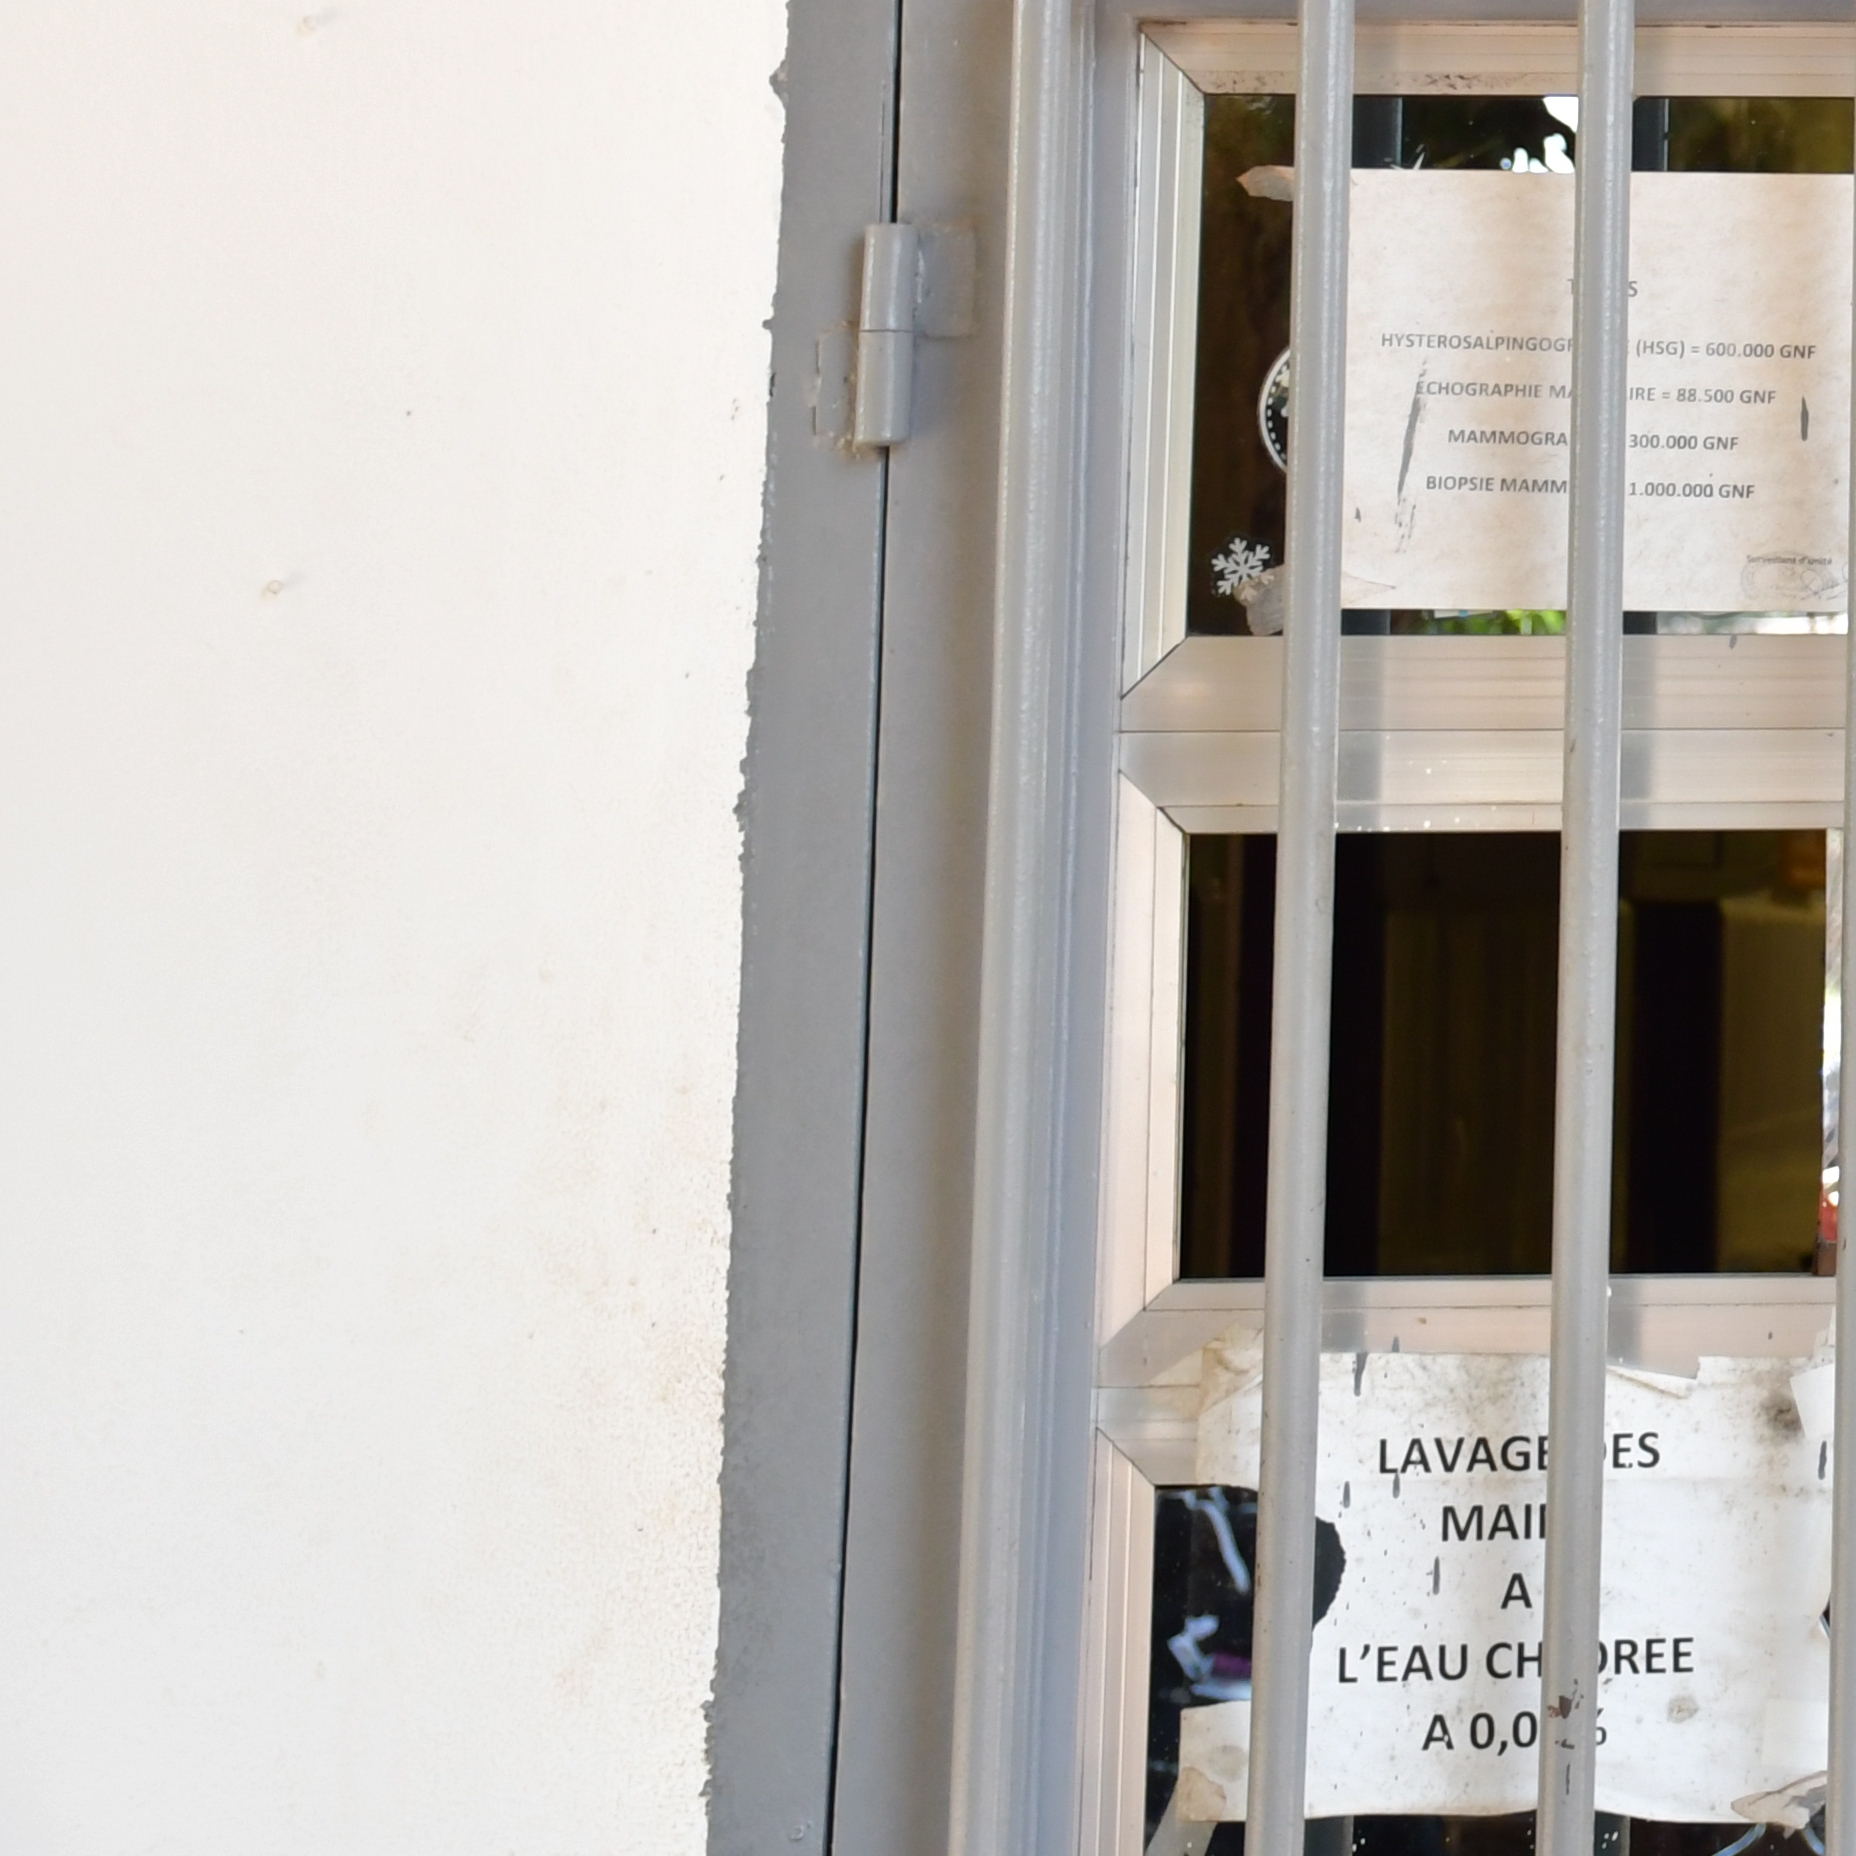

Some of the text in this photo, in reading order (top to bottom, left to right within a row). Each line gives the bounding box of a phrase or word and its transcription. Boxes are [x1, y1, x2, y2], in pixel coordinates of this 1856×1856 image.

[1636, 339, 1685, 359] (HSG)
[1705, 342, 1775, 358] 600.000
[1779, 343, 1817, 359] GNF
[1416, 380, 1543, 398] ECHOGRAPHIE
[1676, 388, 1735, 404] 88.500
[1739, 389, 1777, 404] GNF
[1448, 429, 1739, 451] MAMMOGRA 300.000 GNF
[1426, 475, 1756, 499] BIOPSIE MAMM 1.000.000 GNF
[1602, 1431, 1661, 1469] ES
[1500, 1572, 1533, 1610] A
[1338, 1643, 1469, 1684] L'EAU
[1421, 1713, 1455, 1752] A
